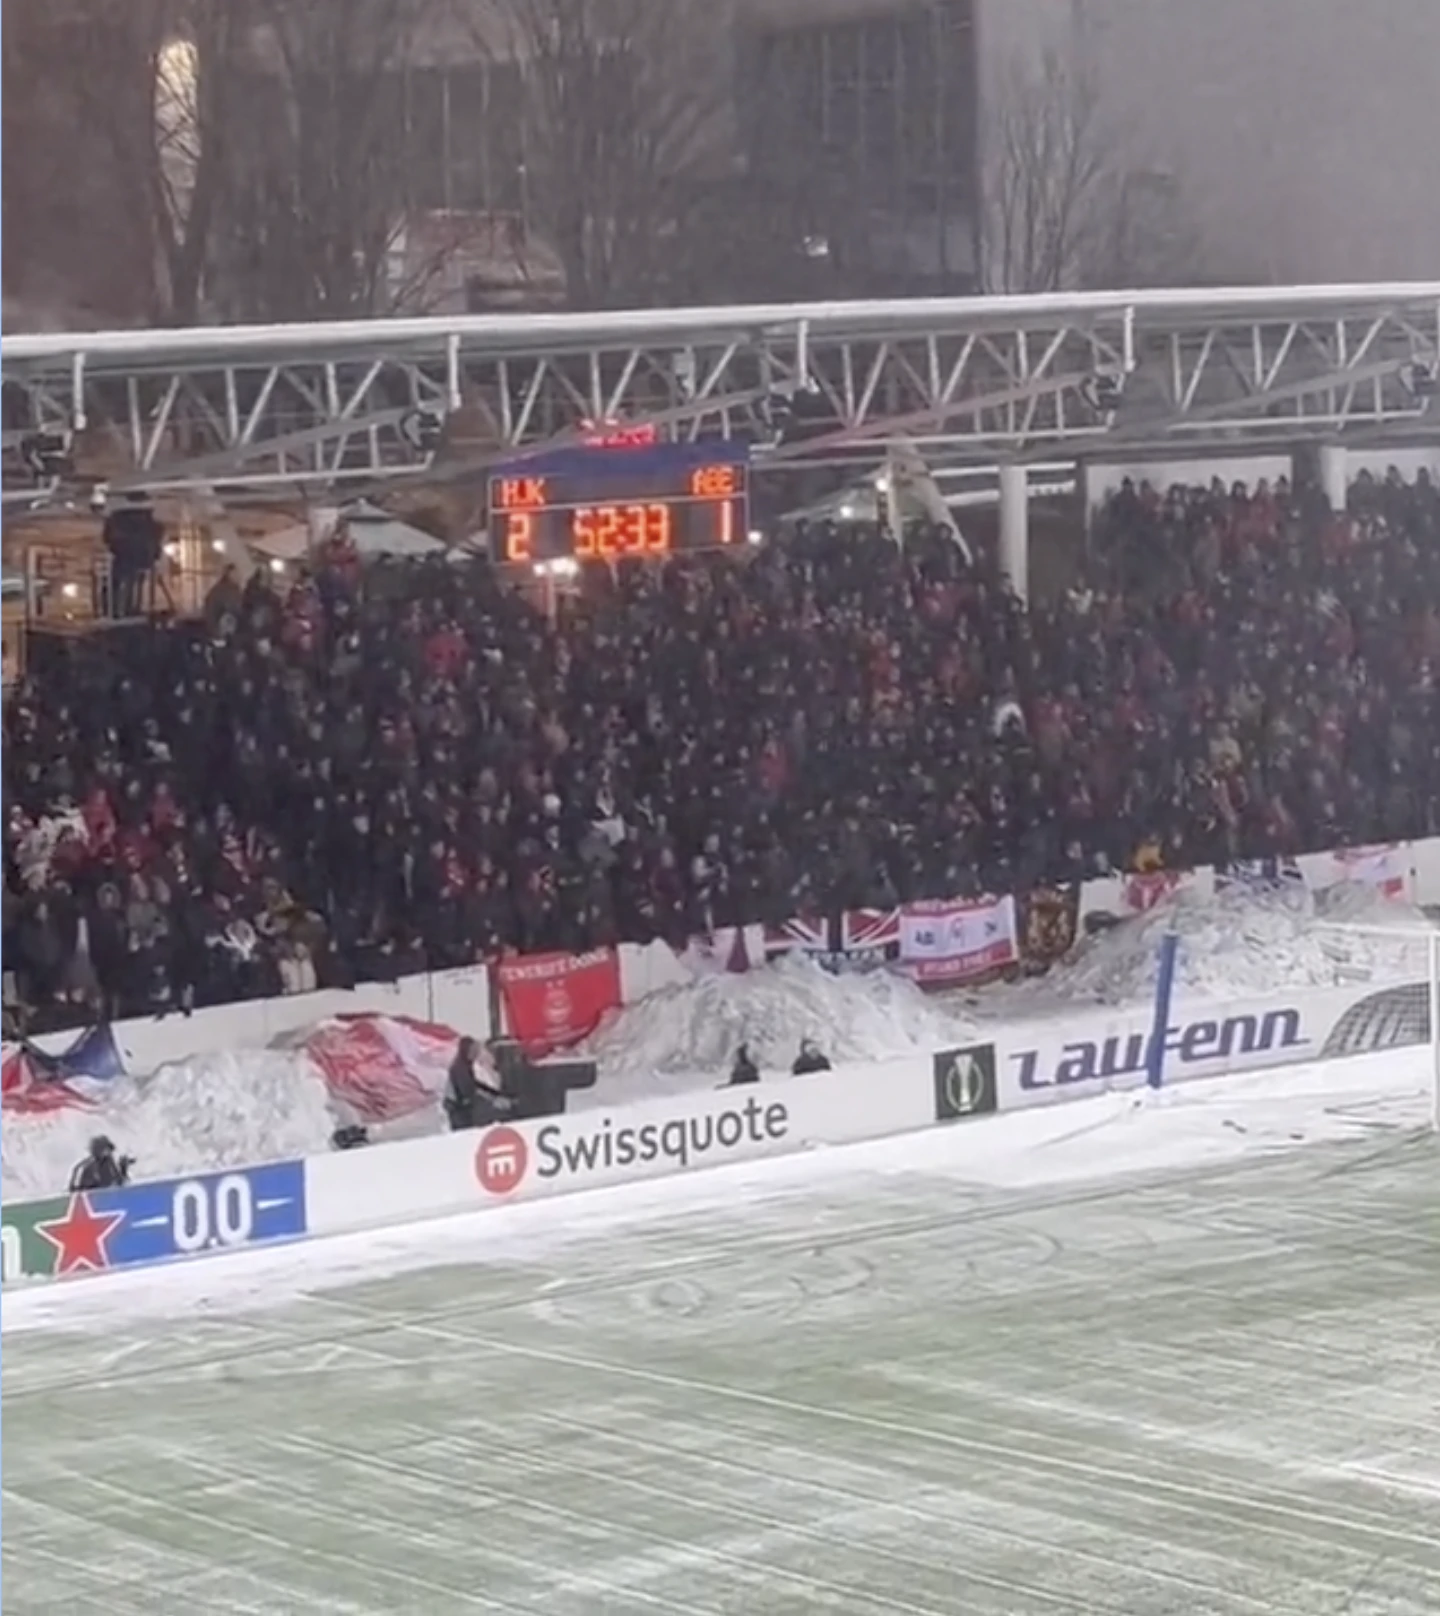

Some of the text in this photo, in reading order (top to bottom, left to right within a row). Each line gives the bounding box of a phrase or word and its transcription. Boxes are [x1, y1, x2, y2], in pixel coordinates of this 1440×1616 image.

[502, 478, 546, 505] HJK
[507, 512, 531, 561] 2
[573, 503, 670, 557] 52:33
[721, 499, 732, 543] 1
[536, 1097, 789, 1178] Swissquote
[172, 1174, 252, 1250] 0.0
